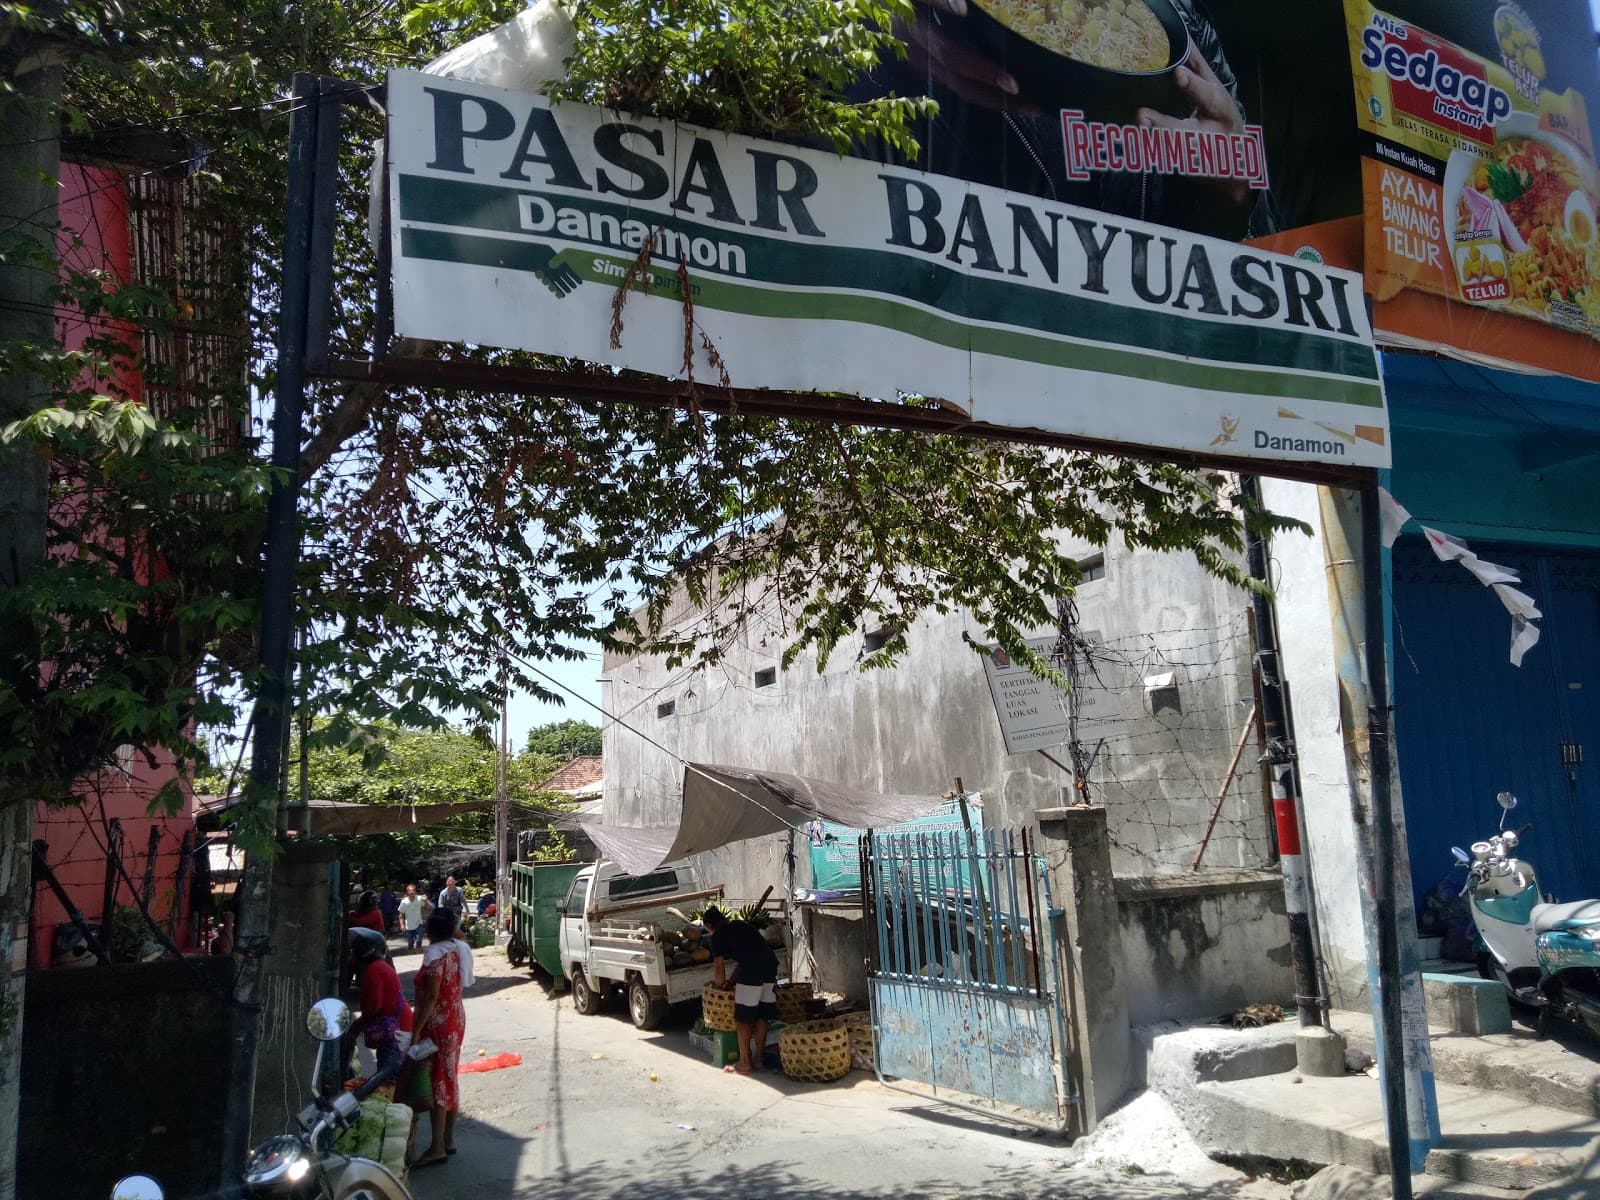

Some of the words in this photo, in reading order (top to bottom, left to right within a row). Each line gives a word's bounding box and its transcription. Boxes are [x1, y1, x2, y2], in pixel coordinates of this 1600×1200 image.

[1373, 14, 1406, 38] Mie
[1361, 28, 1510, 123] Sedaap
[1434, 97, 1483, 129] Instant
[1421, 126, 1450, 146] TERASA
[1400, 152, 1417, 169] Kuah
[1418, 158, 1436, 176] Rasa
[1380, 169, 1439, 212] AYAM
[423, 87, 826, 238] PASAR
[878, 174, 1360, 337] BANYUASRI
[1382, 197, 1441, 240] BAWANG
[518, 194, 747, 274] Danamon
[1383, 226, 1442, 271] TELUR
[1466, 283, 1507, 300] TELUR
[1254, 430, 1346, 455] Danamon
[1004, 687, 1041, 699] TANGGAL
[1006, 699, 1027, 709] LUAS
[1009, 708, 1039, 719] LOKASI
